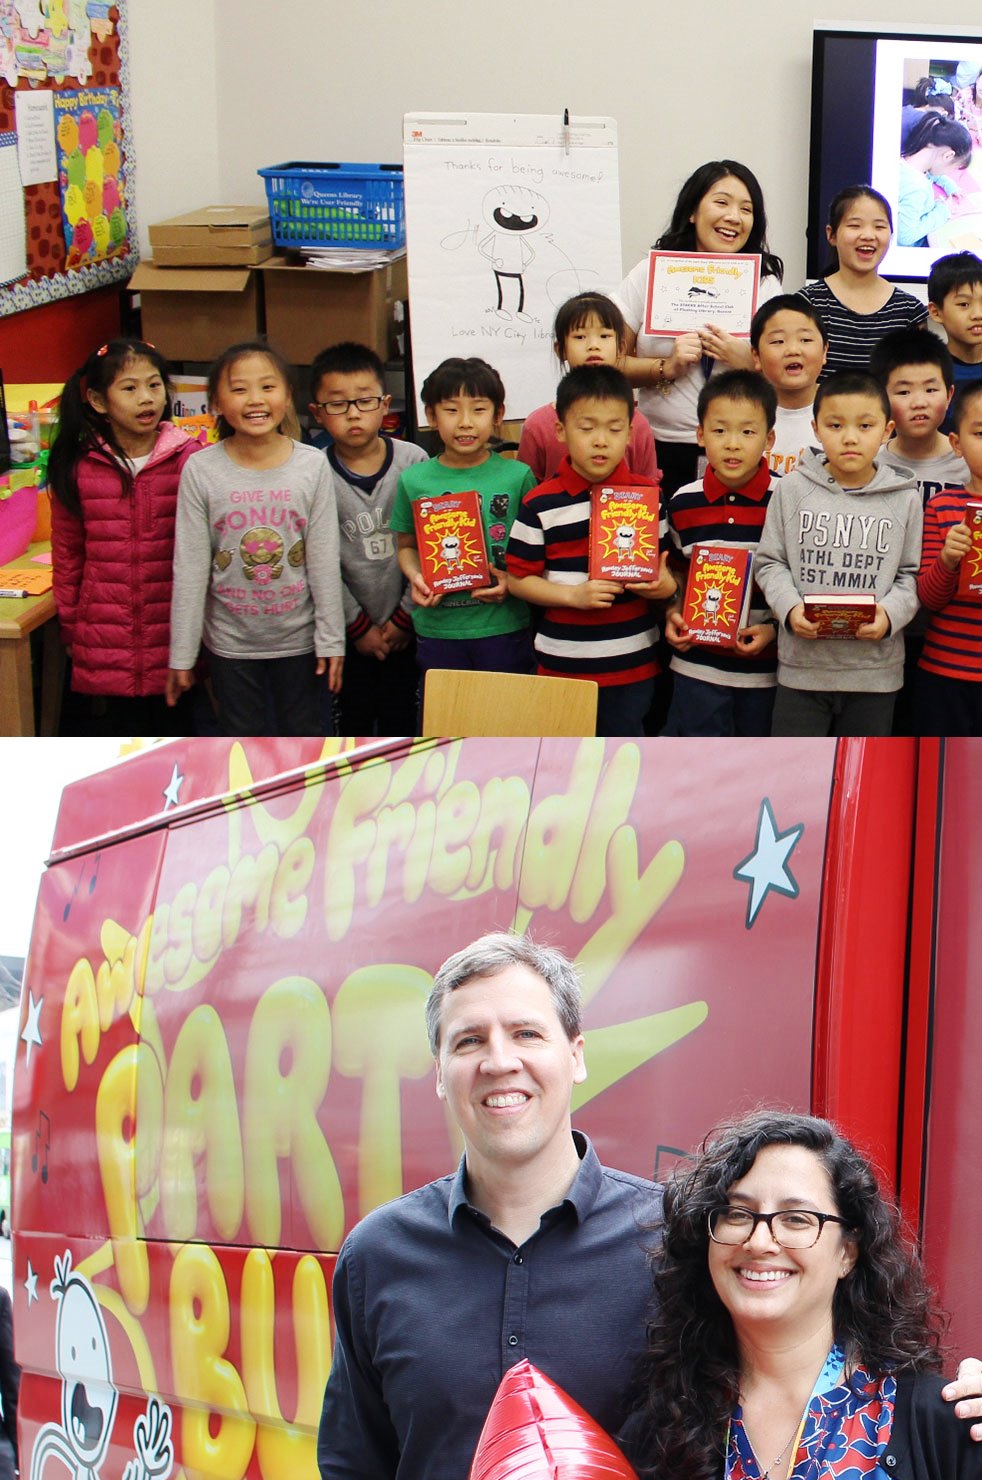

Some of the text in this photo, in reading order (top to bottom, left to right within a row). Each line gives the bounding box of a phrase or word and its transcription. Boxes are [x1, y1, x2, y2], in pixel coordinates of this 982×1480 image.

[54, 92, 107, 110] Happy Birthday
[444, 158, 603, 184] Thanks for being awesome!
[338, 192, 362, 200] Library
[667, 264, 743, 280] Awesome Friendly
[693, 276, 715, 284] KIDS
[452, 327, 556, 345] Love NY City libra
[230, 489, 290, 504] GIVE ME
[608, 501, 648, 512] Awesome
[429, 510, 468, 526] Awesome
[601, 509, 656, 522] Friendly Kid
[341, 507, 390, 542] POL
[424, 518, 476, 534] Friendly Kid
[798, 510, 892, 554] PSNYC
[370, 540, 388, 554] 67
[800, 548, 885, 571] ATHL DEPT
[611, 570, 642, 578] JOURNAL
[702, 564, 736, 575] Awesome
[443, 580, 474, 591] JOURNAL
[695, 571, 740, 588] Friendly Kid
[216, 582, 247, 600] AND
[252, 589, 276, 600] NO
[263, 598, 300, 615] HURT
[696, 635, 722, 644] JOURNAL
[60, 737, 686, 1093] Awesome Friendly
[95, 963, 435, 1316] PART
